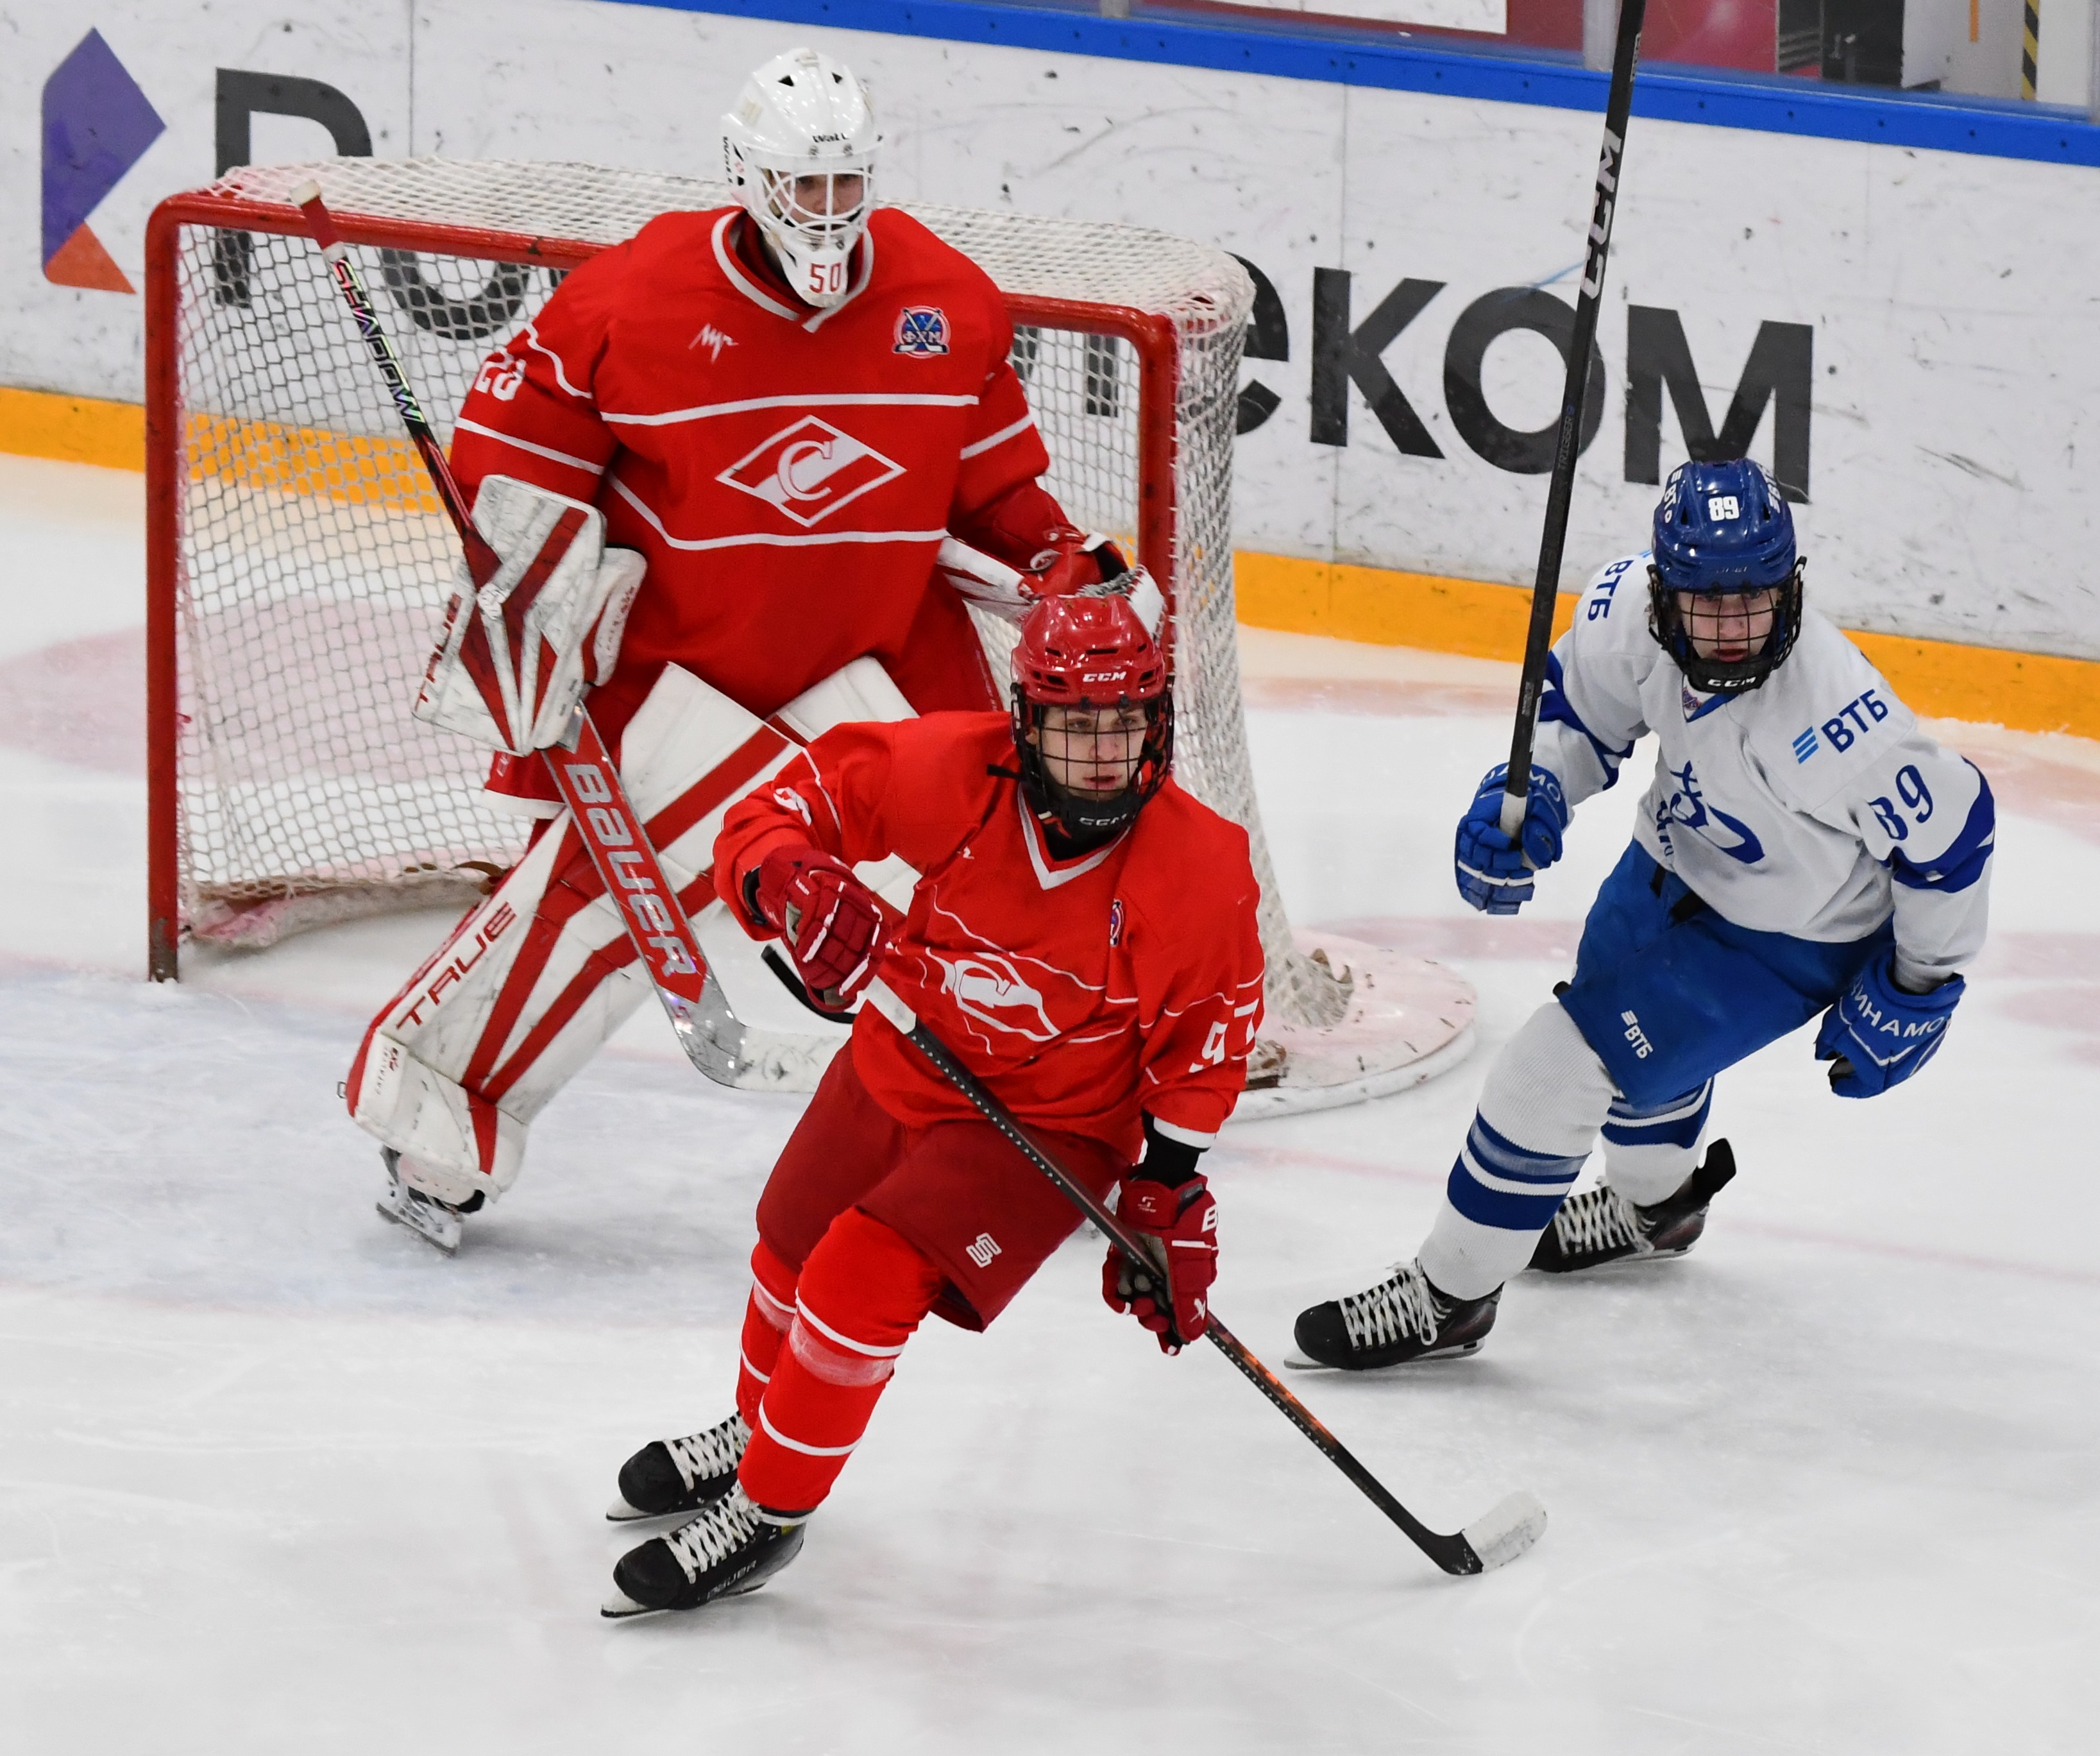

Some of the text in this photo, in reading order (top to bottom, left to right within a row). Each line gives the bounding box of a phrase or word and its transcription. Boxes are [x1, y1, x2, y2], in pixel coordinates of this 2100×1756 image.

[1580, 127, 1622, 300] CCM
[809, 262, 842, 293] 50
[332, 259, 426, 423] SHADOW
[1708, 496, 1740, 521] 89
[1588, 559, 1634, 621] ВТБ
[414, 592, 461, 712] TRUE
[1083, 671, 1127, 682] CCM
[1707, 677, 1756, 687] CCM
[1821, 688, 1888, 754] ВТБ
[1868, 765, 1933, 840] 89
[396, 901, 517, 1030] TRUE
[1624, 1025, 1653, 1059] ВТБ
